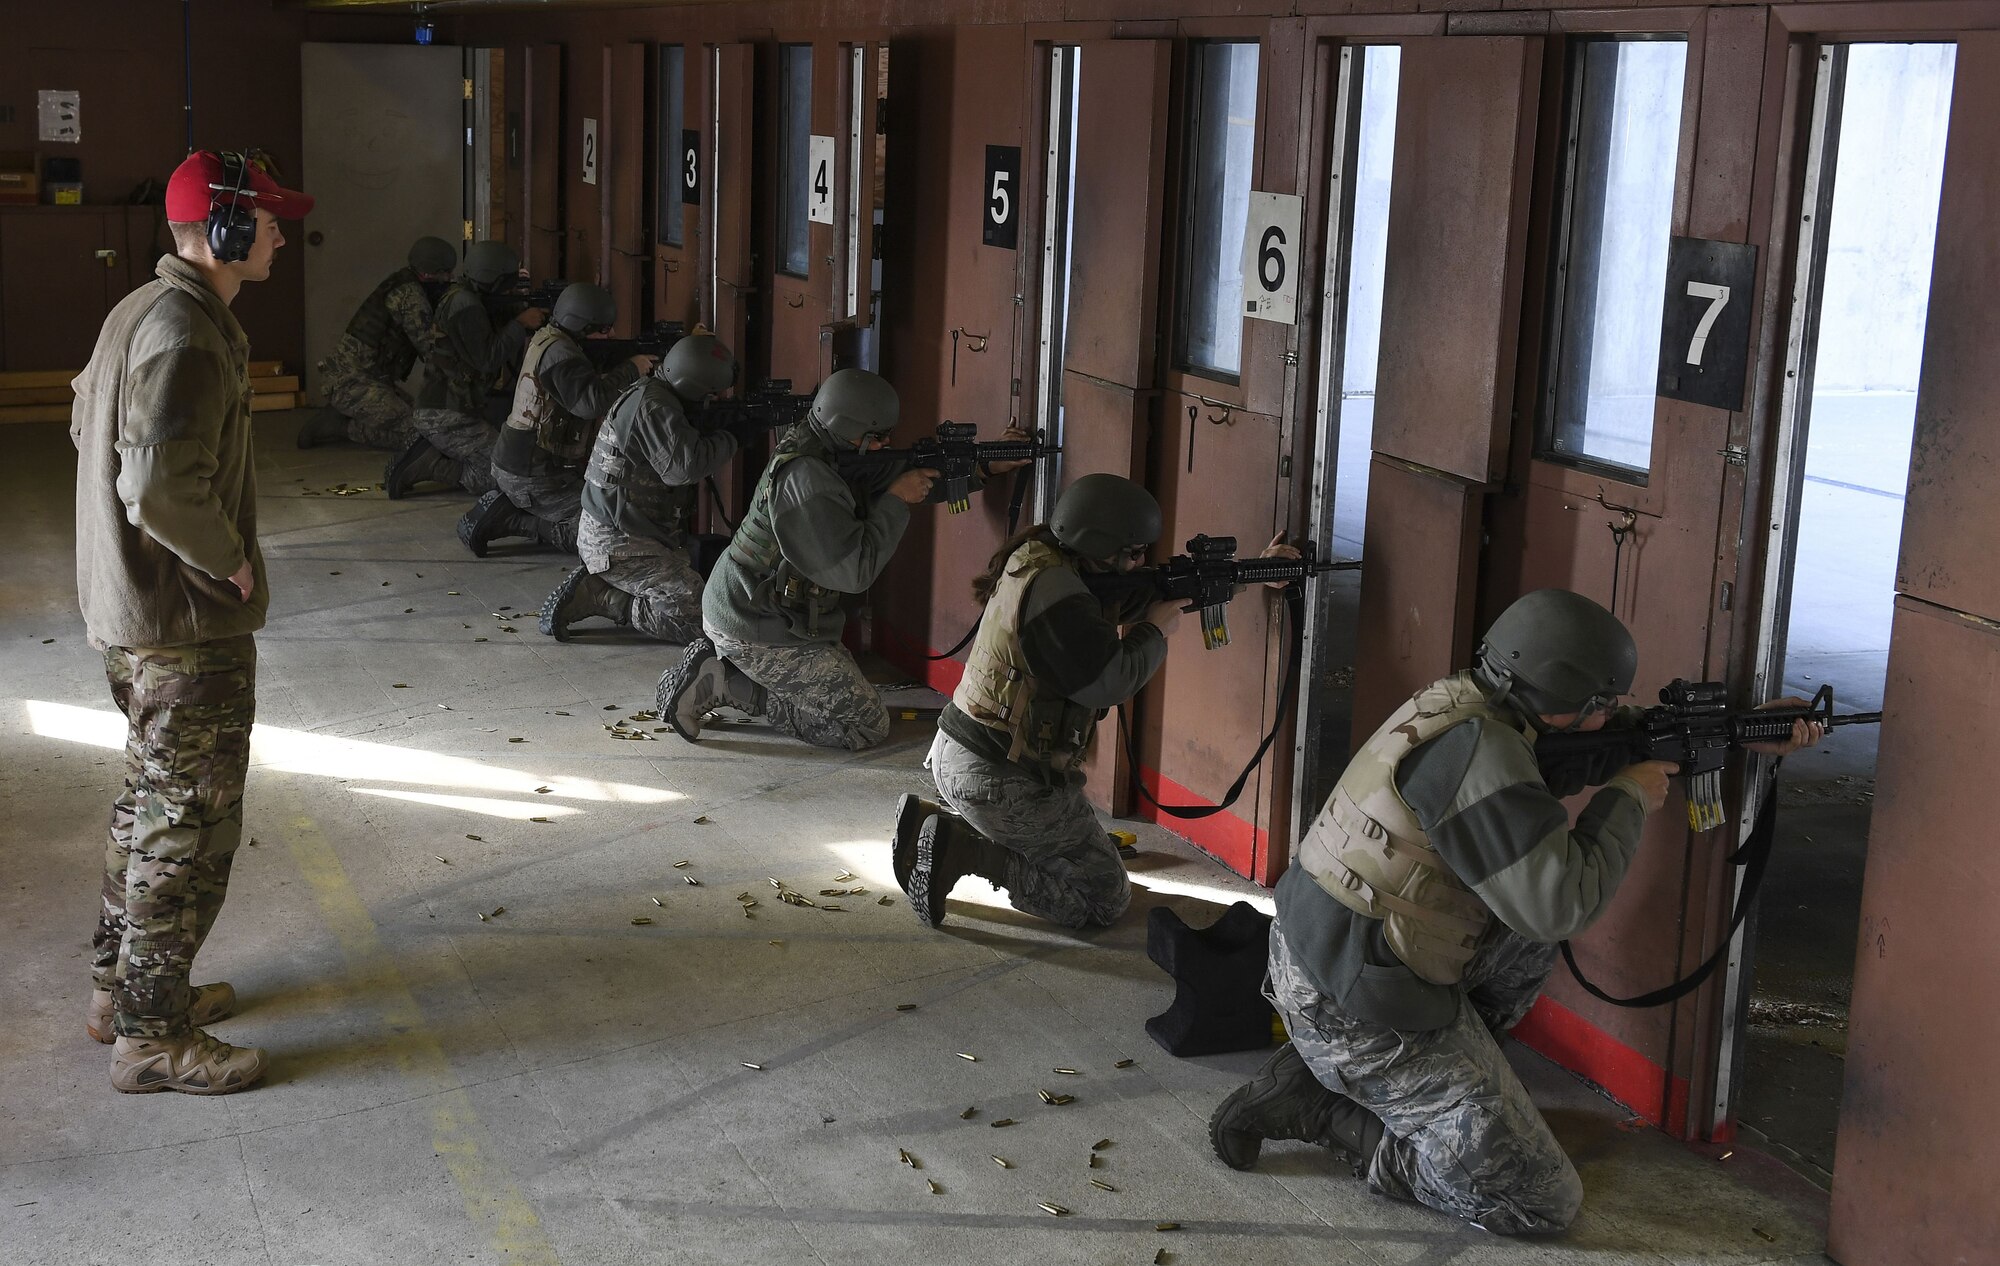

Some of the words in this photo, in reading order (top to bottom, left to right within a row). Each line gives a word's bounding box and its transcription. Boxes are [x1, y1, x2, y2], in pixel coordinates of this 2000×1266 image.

[511, 127, 516, 158] 1
[586, 133, 594, 167] 2
[686, 148, 697, 189] 3
[814, 159, 828, 203] 4
[991, 171, 1009, 224] 5
[1257, 225, 1287, 292] 6
[1686, 281, 1731, 366] 7
